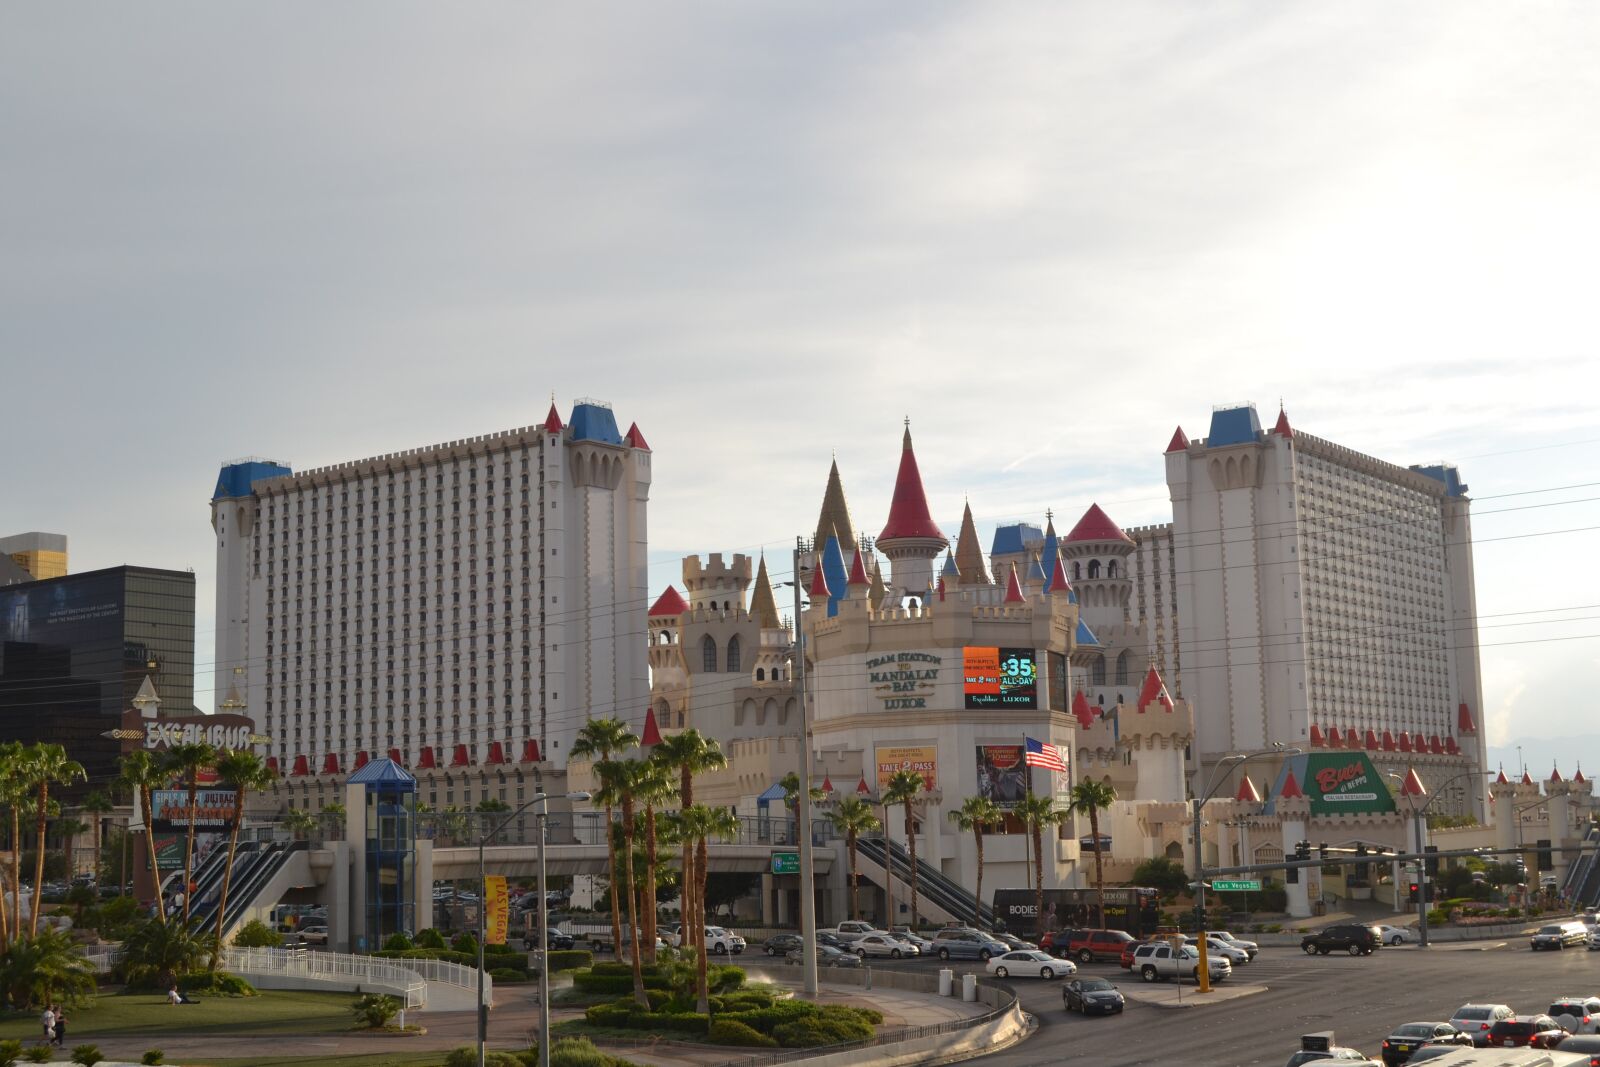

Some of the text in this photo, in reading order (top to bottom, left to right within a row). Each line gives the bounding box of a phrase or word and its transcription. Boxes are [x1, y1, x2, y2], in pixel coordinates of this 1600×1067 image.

[866, 652, 941, 669] TRAM STATION
[1001, 658, 1032, 677] $35
[870, 669, 939, 682] MANDALAY
[978, 676, 984, 684] 2
[1002, 677, 1033, 685] ALL-DAY
[893, 681, 916, 692] BAY
[885, 698, 926, 710] LUXOR
[972, 695, 998, 705] Excalibur
[145, 722, 249, 750] EXCALIBUR
[881, 761, 932, 772] TAKE 2 PASS
[1347, 776, 1367, 790] BEPPO
[156, 792, 178, 803] GIRLS
[495, 885, 507, 941] LAS VEGAS
